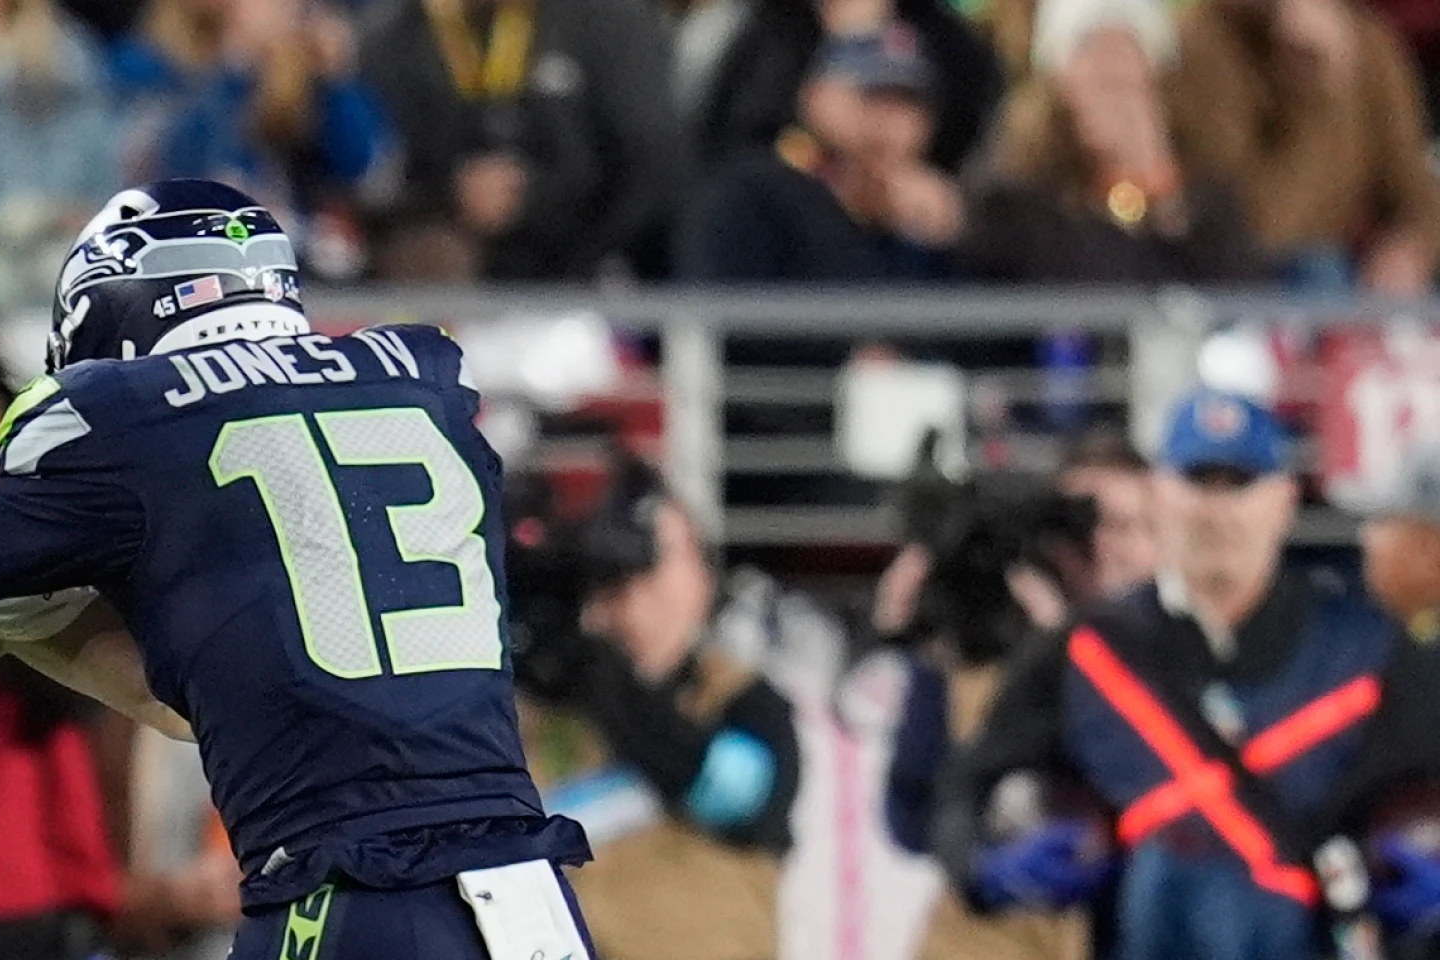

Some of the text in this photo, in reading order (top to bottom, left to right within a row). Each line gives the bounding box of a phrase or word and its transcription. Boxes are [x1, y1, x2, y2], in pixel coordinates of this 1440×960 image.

[152, 295, 177, 318] 45
[164, 329, 421, 408] JONES IV
[207, 406, 503, 680] 13
